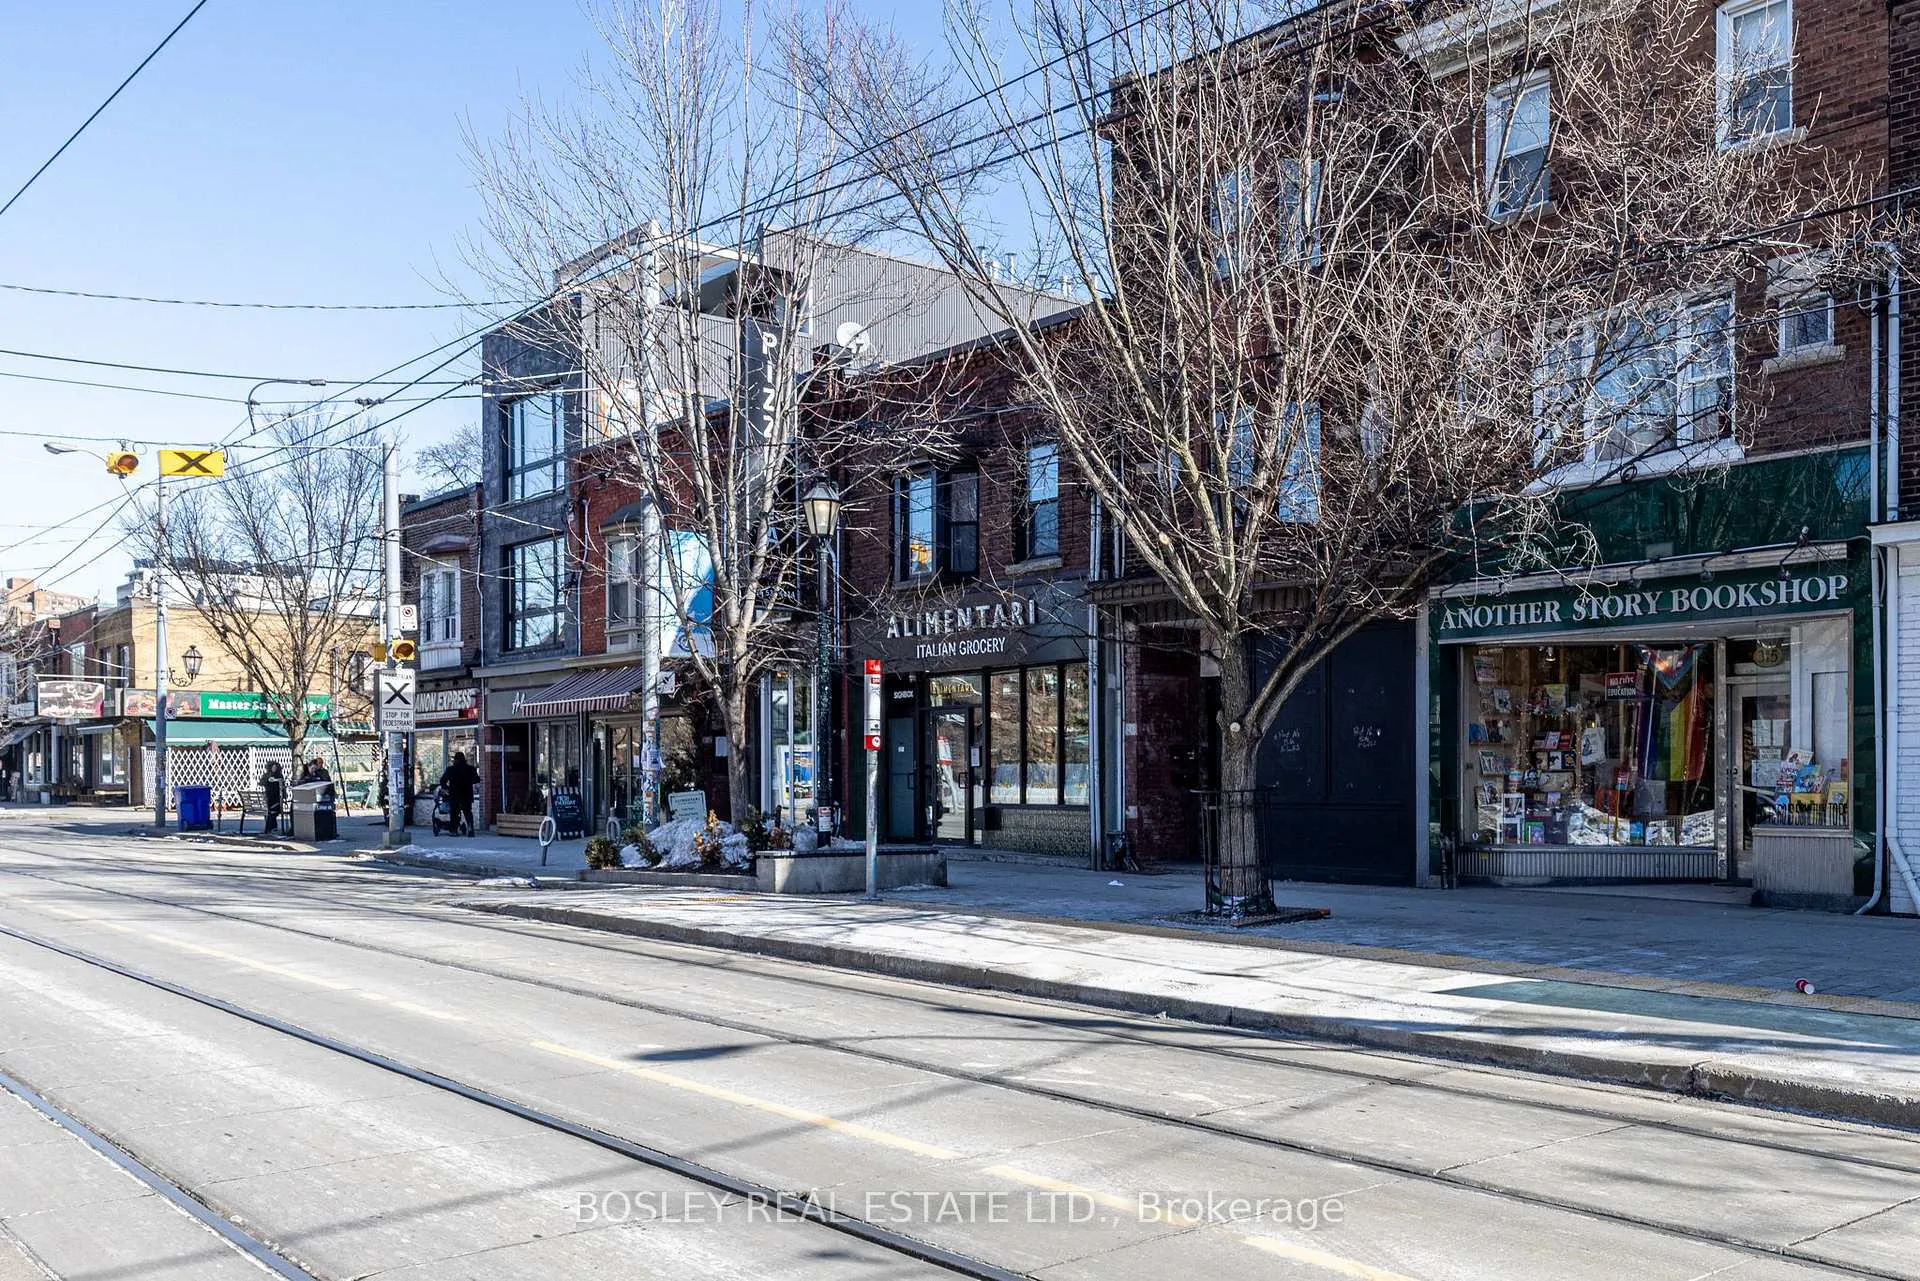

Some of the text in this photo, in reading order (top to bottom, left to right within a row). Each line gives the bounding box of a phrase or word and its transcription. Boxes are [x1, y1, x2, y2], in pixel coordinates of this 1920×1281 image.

[1440, 574, 1849, 631] ANOTHER STORY BOOKSHOP
[886, 599, 1035, 639] ALIMENTARI
[916, 636, 1006, 659] ITALIAN GROCERY
[438, 688, 472, 710] EXPRESS
[1608, 687, 1636, 697] EDUCATION
[208, 699, 250, 710] Master
[382, 719, 413, 727] PEDESTRIANS
[385, 711, 398, 719] STOP
[400, 711, 410, 719] FOR
